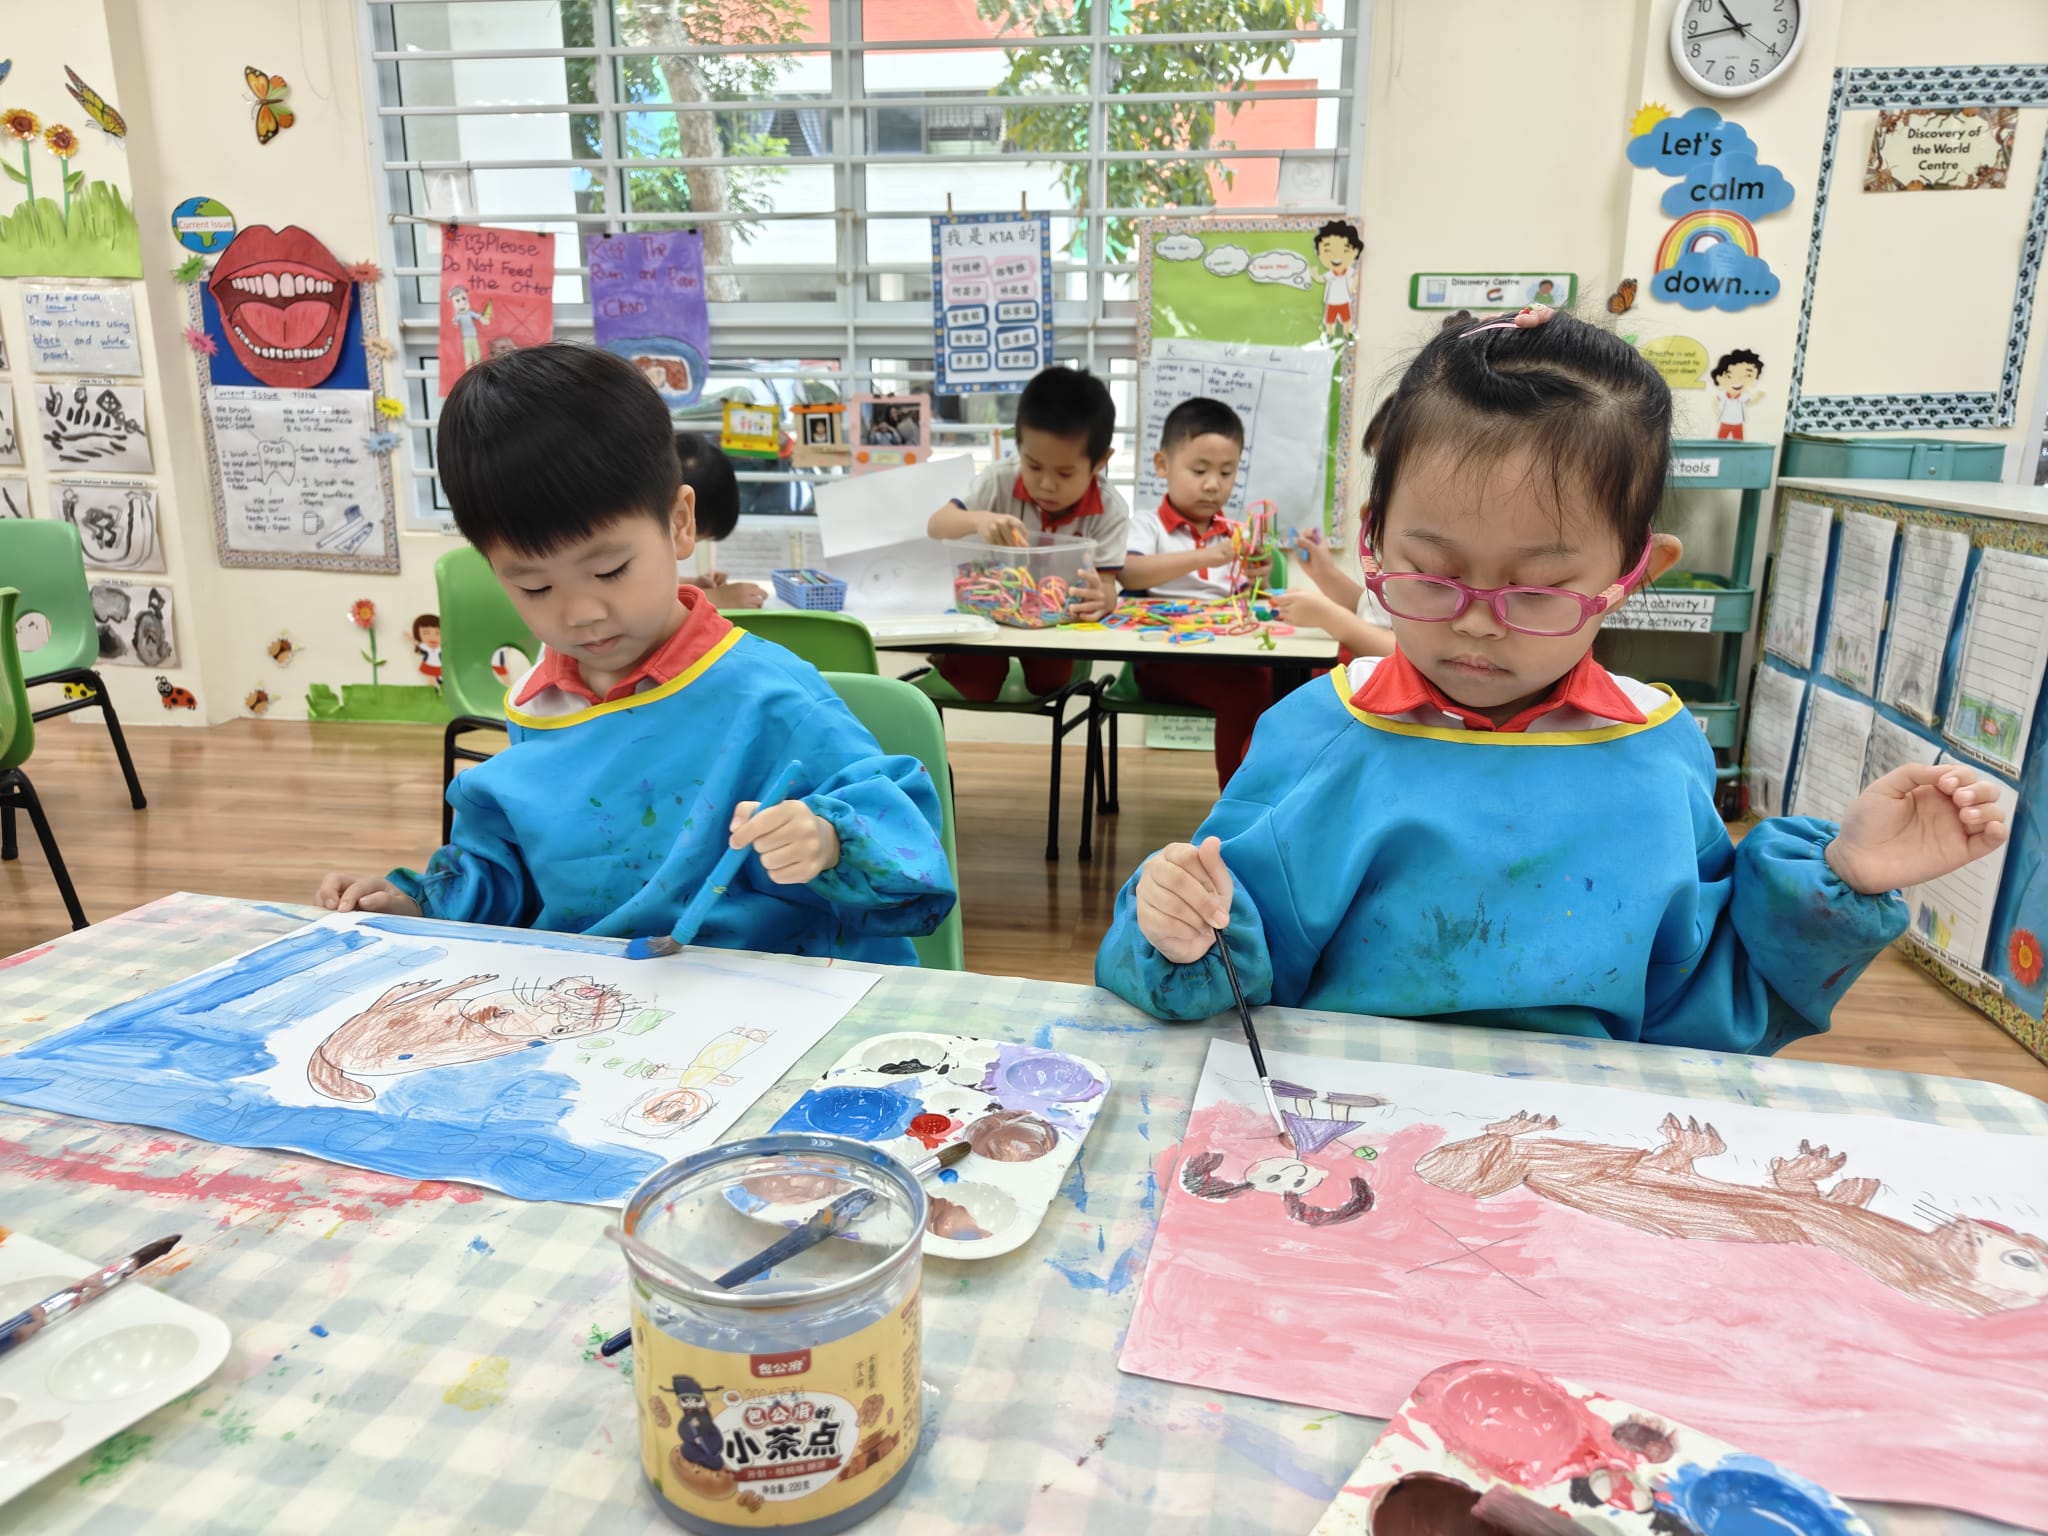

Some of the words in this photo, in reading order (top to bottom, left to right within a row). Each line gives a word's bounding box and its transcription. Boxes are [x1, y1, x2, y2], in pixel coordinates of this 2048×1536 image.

[1688, 20, 1698, 35] 9
[1777, 19, 1788, 34] 3
[1690, 43, 1701, 58] 8
[1767, 42, 1777, 56] 4
[1705, 60, 1716, 74] 7
[1725, 66, 1736, 81] 6
[1749, 59, 1760, 73] 5
[1907, 128, 1966, 140] Discovery
[1968, 126, 1982, 137] of
[1661, 132, 1723, 157] Let's
[1912, 145, 1931, 155] the
[1934, 143, 1971, 154] World
[1918, 160, 1959, 171] Centre
[1690, 177, 1764, 202] calm
[178, 220, 210, 230] Current
[487, 232, 540, 256] Please
[442, 254, 460, 271] Do
[468, 257, 494, 273] Not
[502, 261, 534, 278] Feed
[468, 275, 500, 290] the
[1451, 278, 1489, 287] Discovery
[1493, 278, 1520, 286] Centre
[1664, 270, 1771, 296] down...
[58, 317, 101, 328] pictures
[74, 335, 92, 346] and
[1680, 461, 1711, 473] tools
[1647, 616, 1696, 631] activity
[1700, 618, 1708, 629] 2
[758, 1359, 804, 1375] 包公府
[726, 1421, 842, 1464] 小茶点
